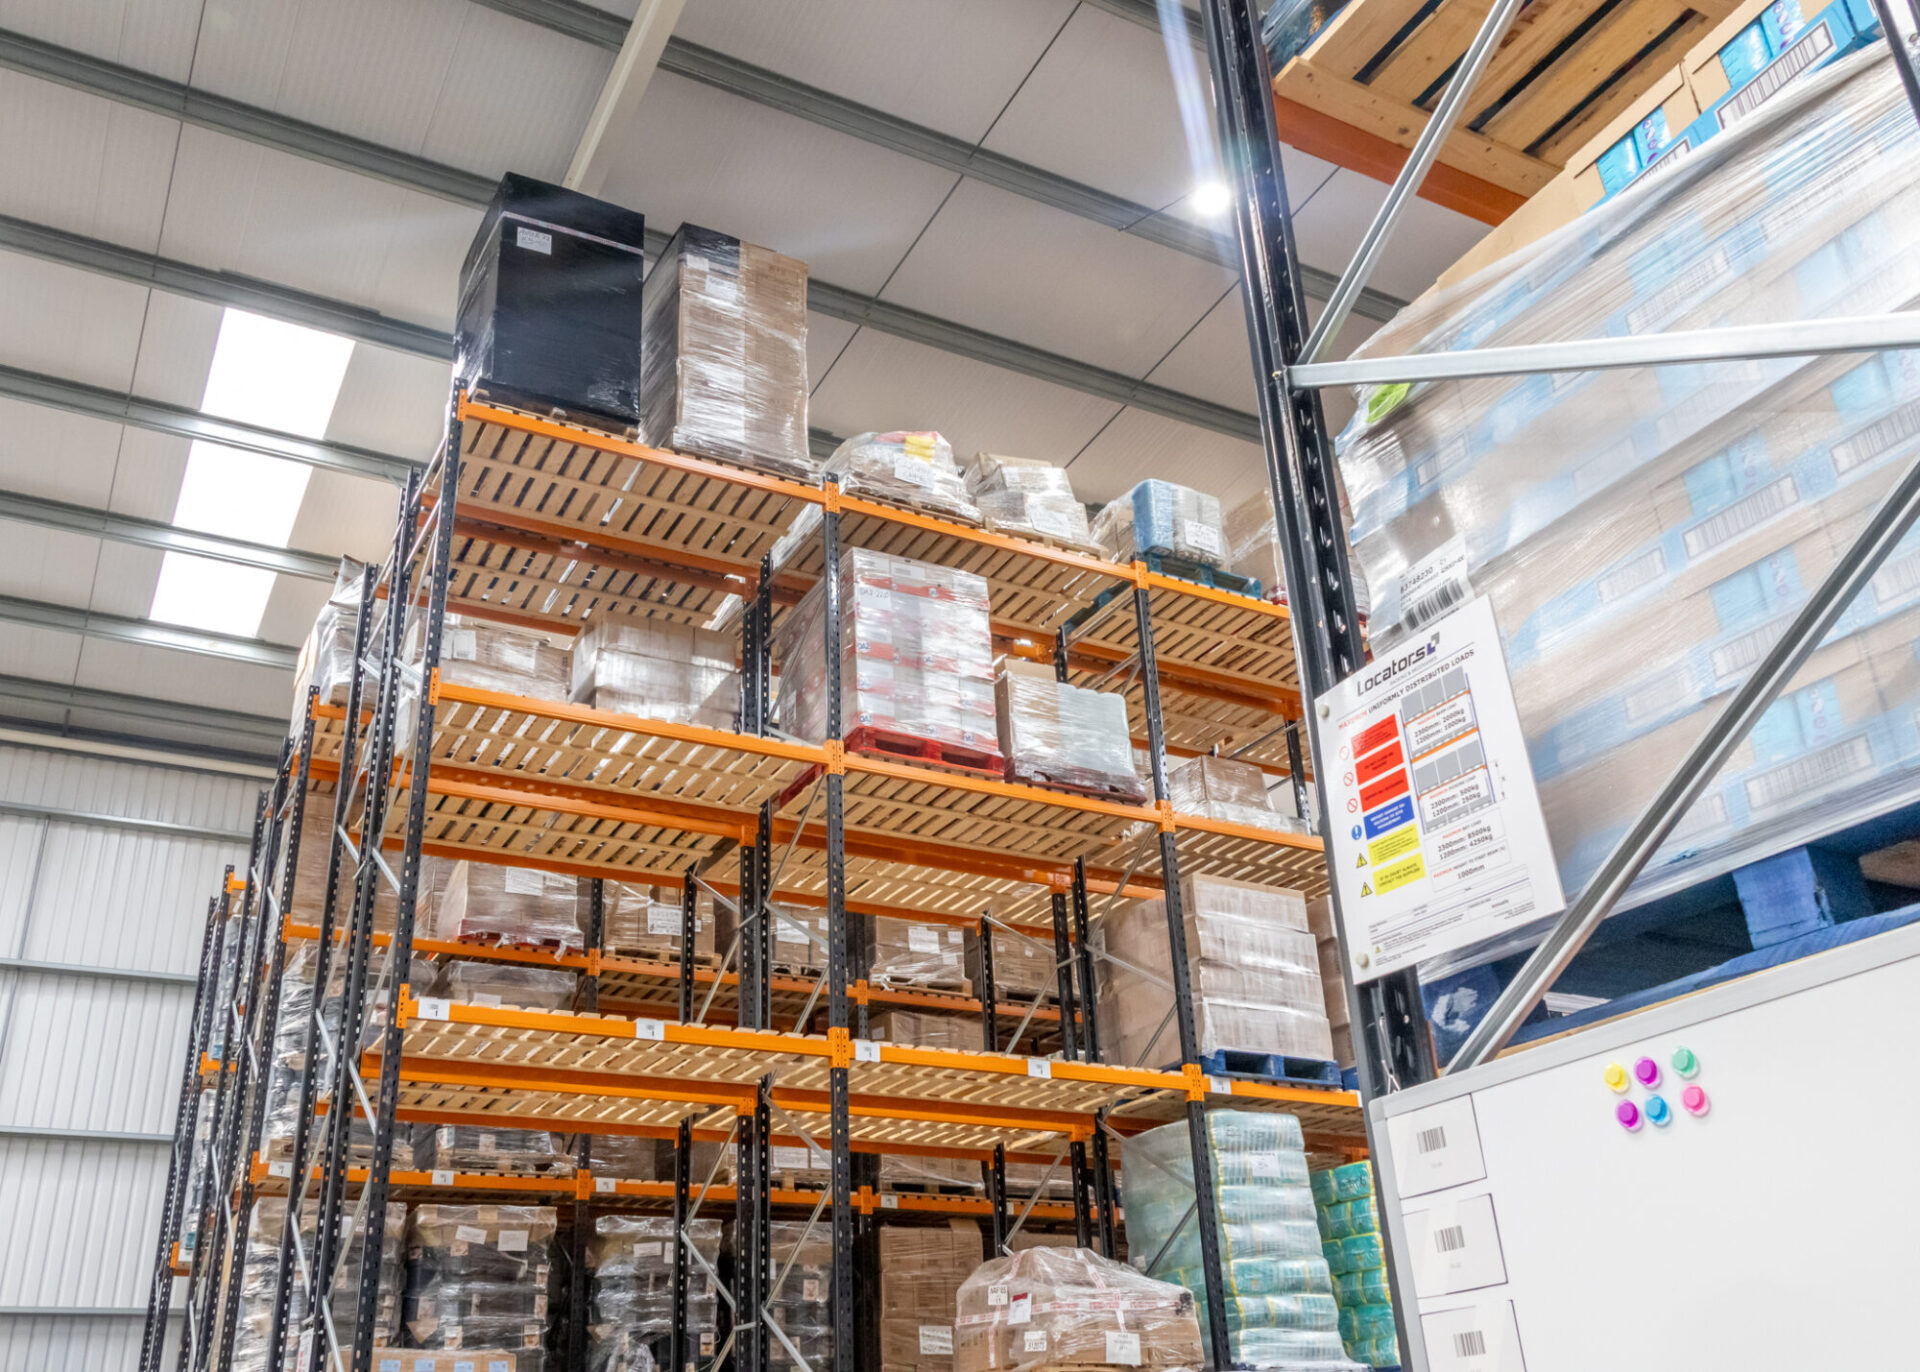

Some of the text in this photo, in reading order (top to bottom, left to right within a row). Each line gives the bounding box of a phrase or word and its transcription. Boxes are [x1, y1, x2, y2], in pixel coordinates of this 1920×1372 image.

[1357, 646, 1425, 696] Locators
[1369, 690, 1404, 713] UNIFORMLY
[1406, 664, 1450, 692] DISTRIBUTED
[1451, 650, 1475, 666] LOADS
